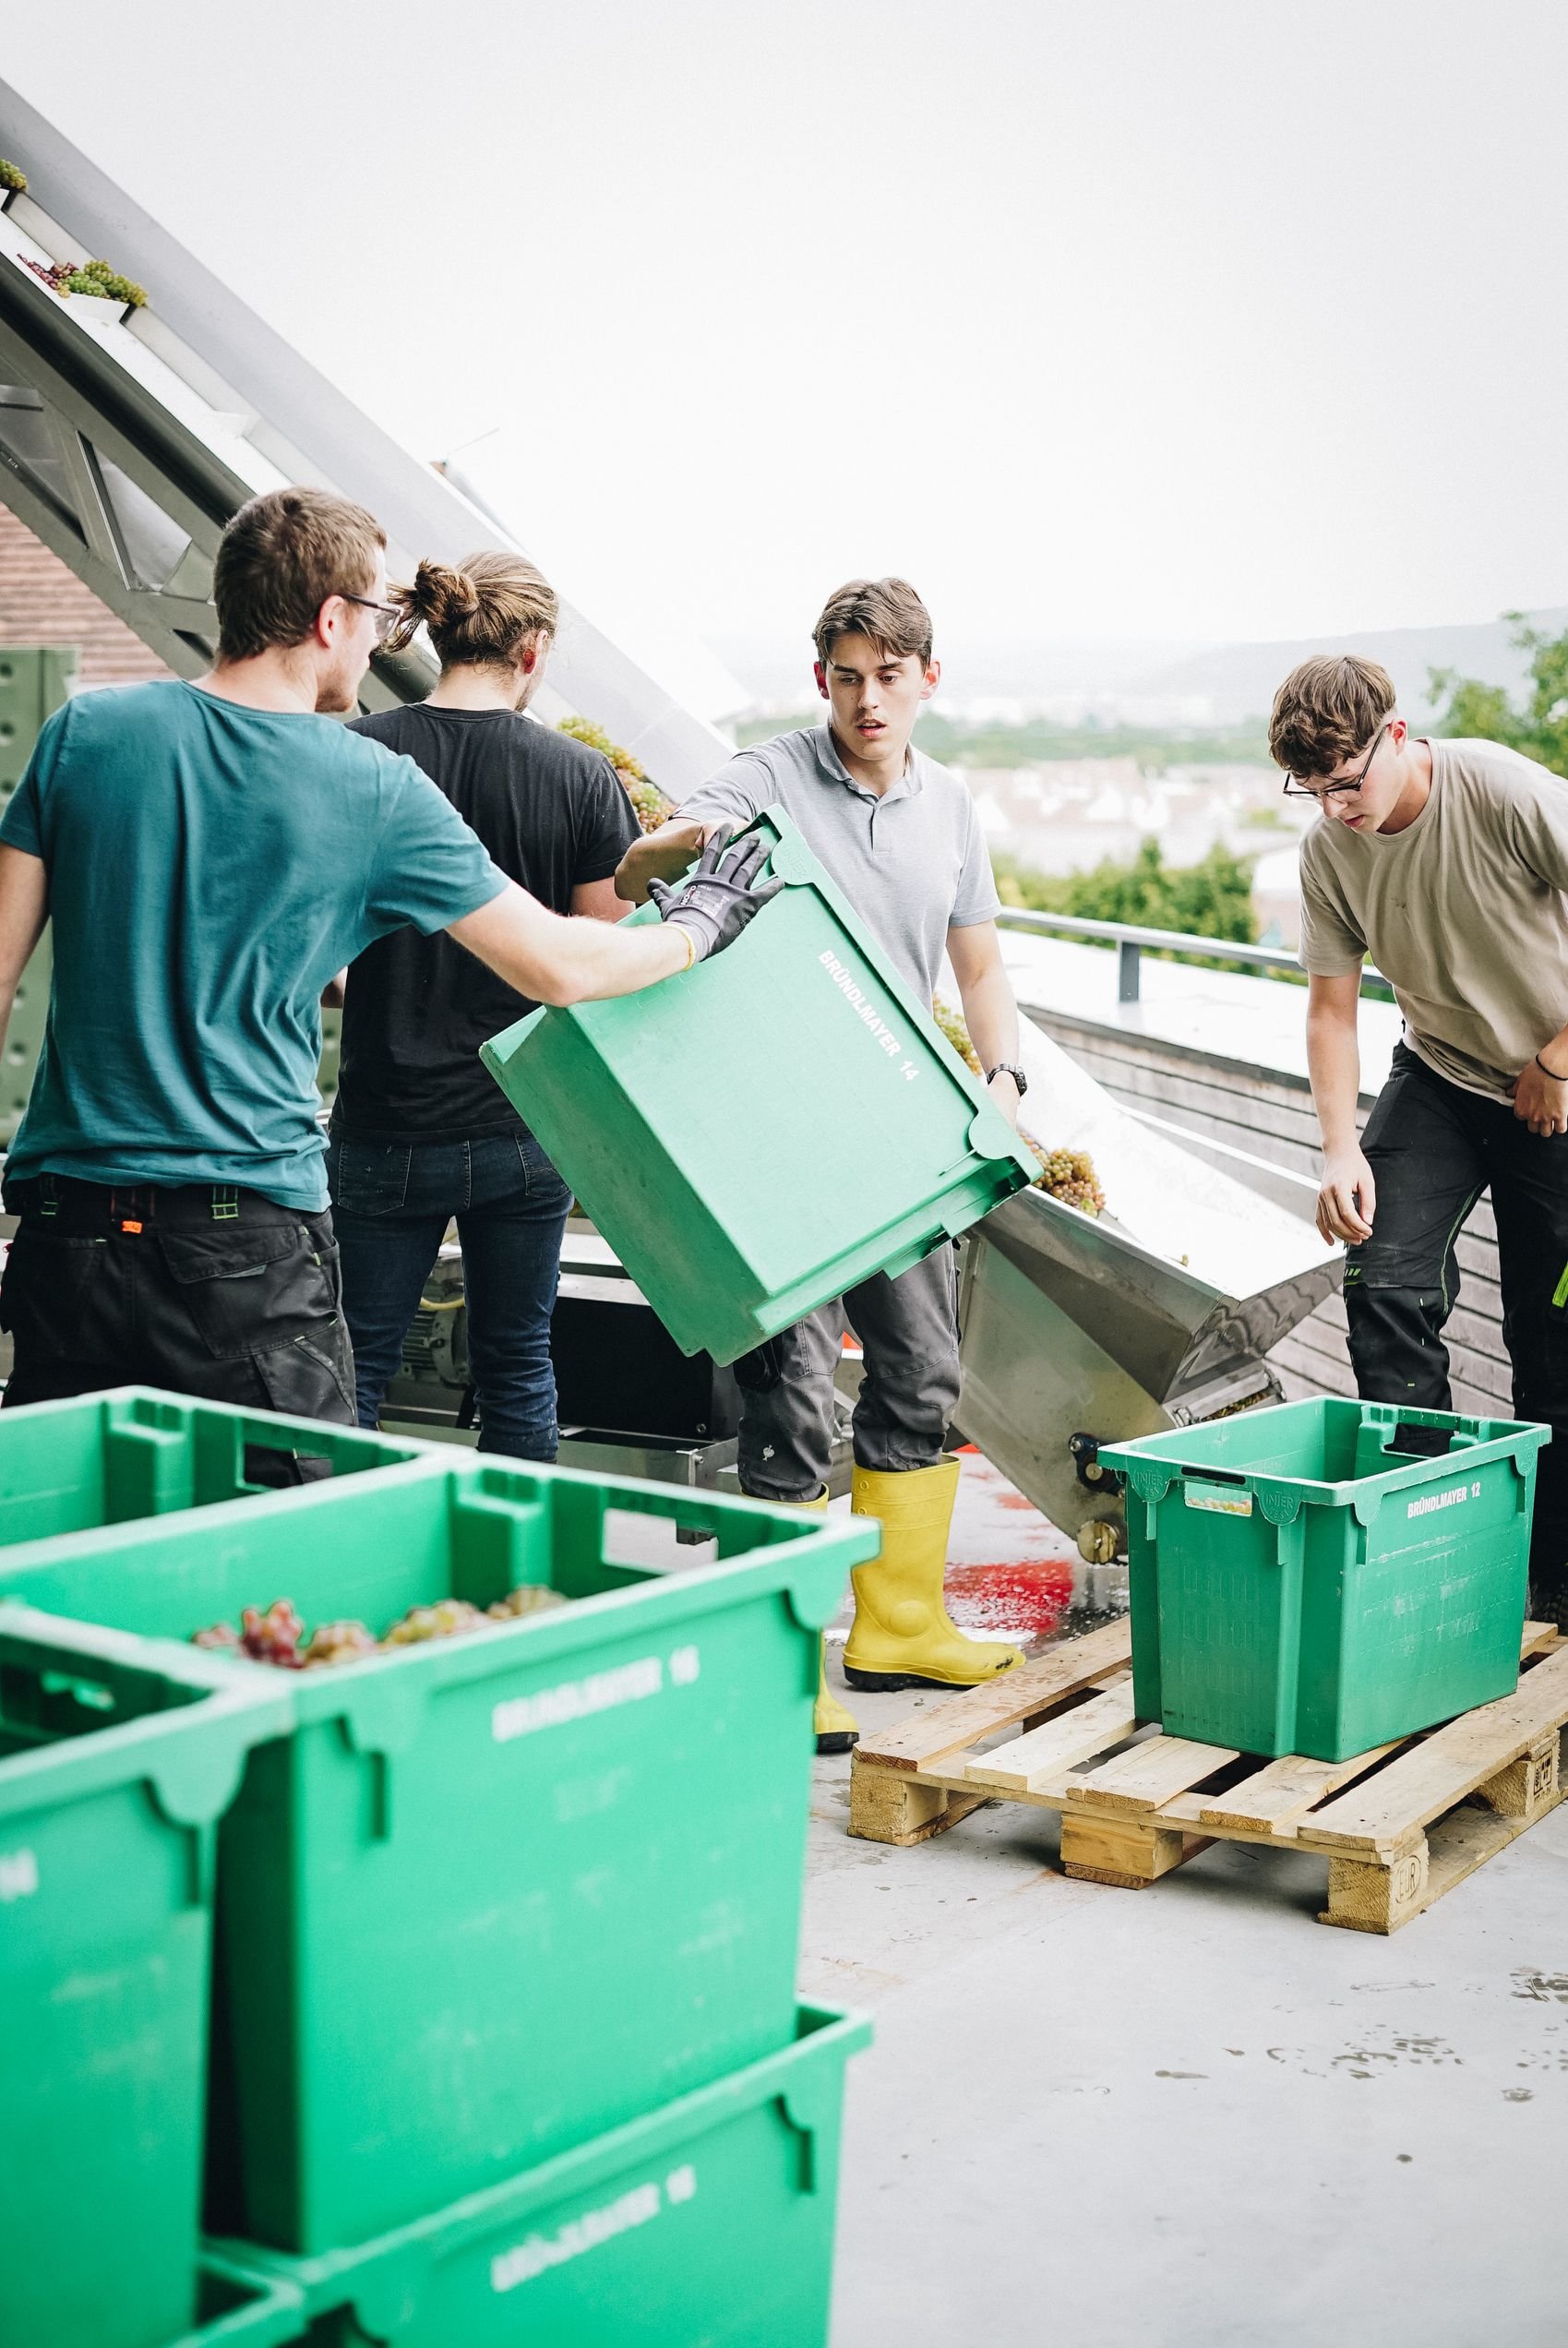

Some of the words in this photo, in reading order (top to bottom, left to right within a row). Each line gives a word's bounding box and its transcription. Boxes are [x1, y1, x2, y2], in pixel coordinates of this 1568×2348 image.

[818, 949, 902, 1058] BRÜNDLMAYER
[899, 1060, 920, 1081] 14
[1265, 1491, 1294, 1508] INTER
[1406, 1486, 1467, 1519] BRÜNDLMAYER
[1471, 1481, 1481, 1499] 12
[1399, 1862, 1416, 1899] EUR
